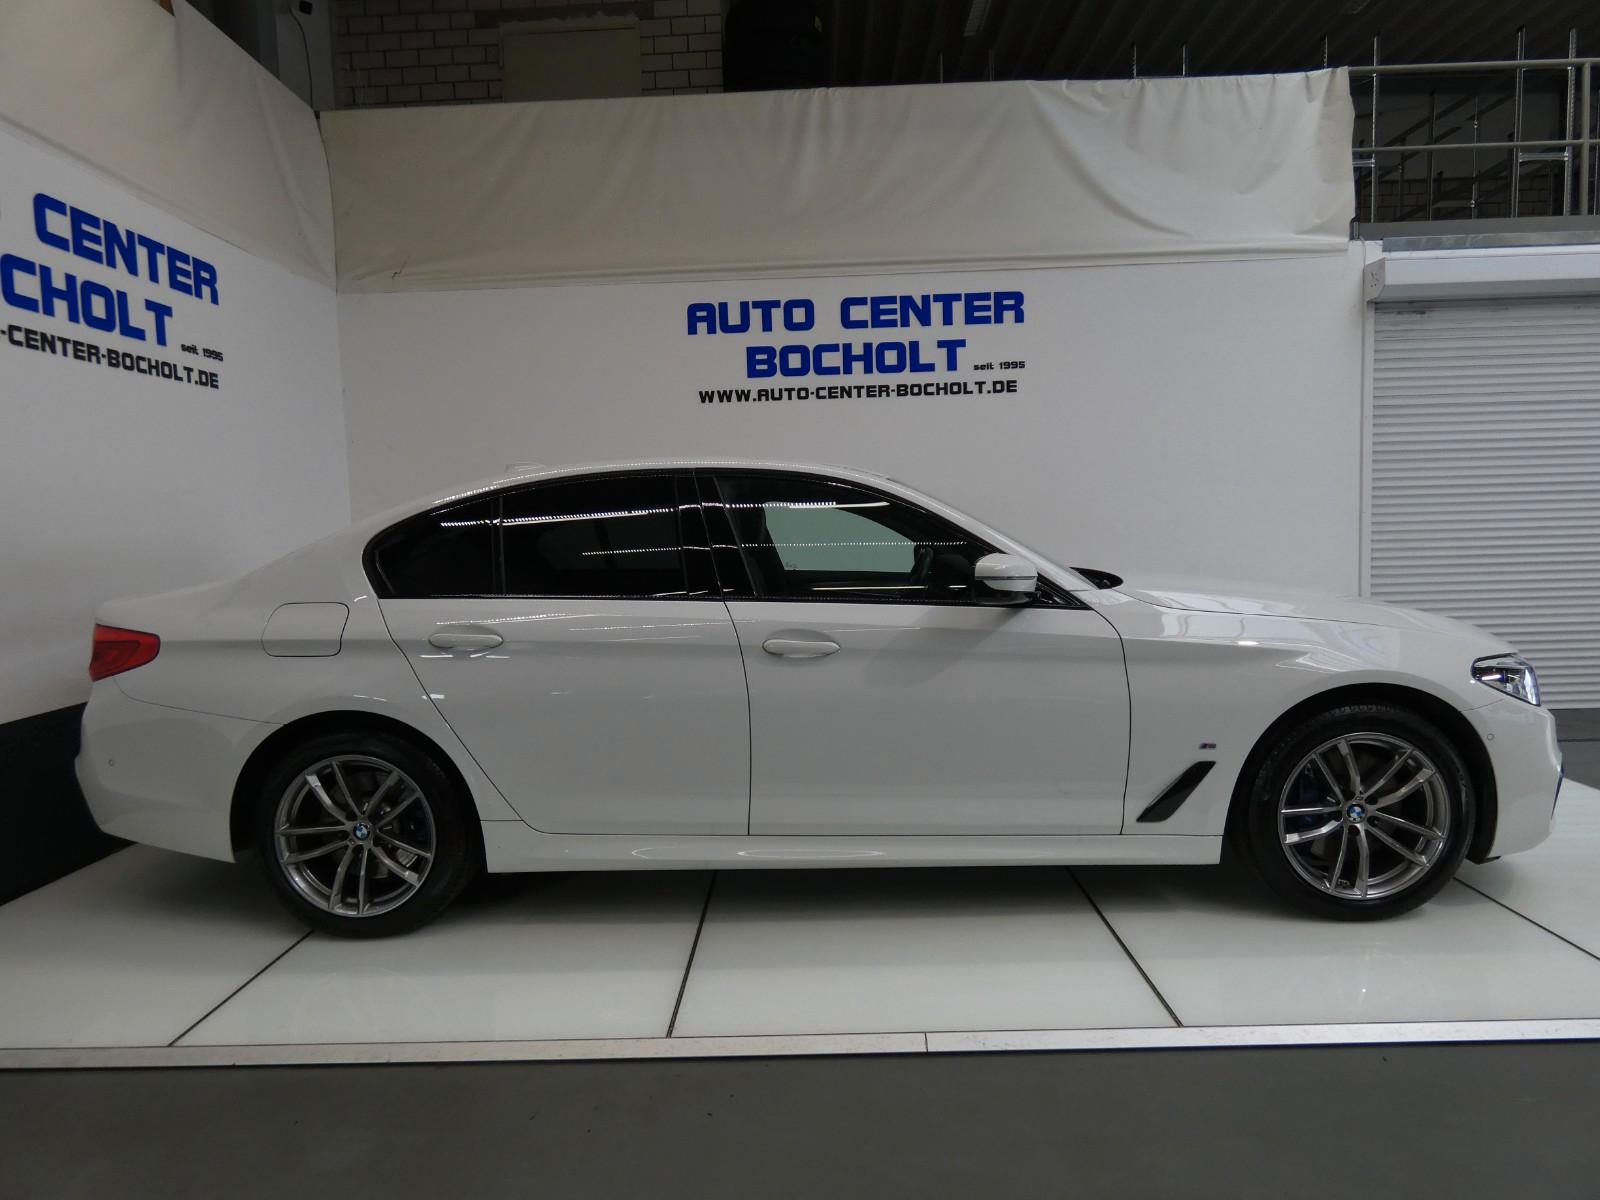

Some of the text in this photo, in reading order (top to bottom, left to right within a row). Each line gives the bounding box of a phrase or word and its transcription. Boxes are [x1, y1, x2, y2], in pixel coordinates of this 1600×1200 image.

[33, 193, 219, 305] CENTER
[687, 291, 1025, 335] AUTO CENTER
[180, 343, 224, 362] seit 1995
[746, 339, 967, 378] BOCHOLT
[973, 360, 1026, 371] seit 1995
[698, 379, 1018, 404] WWW.AUTO-CENTER-BOCHOLT.DE
